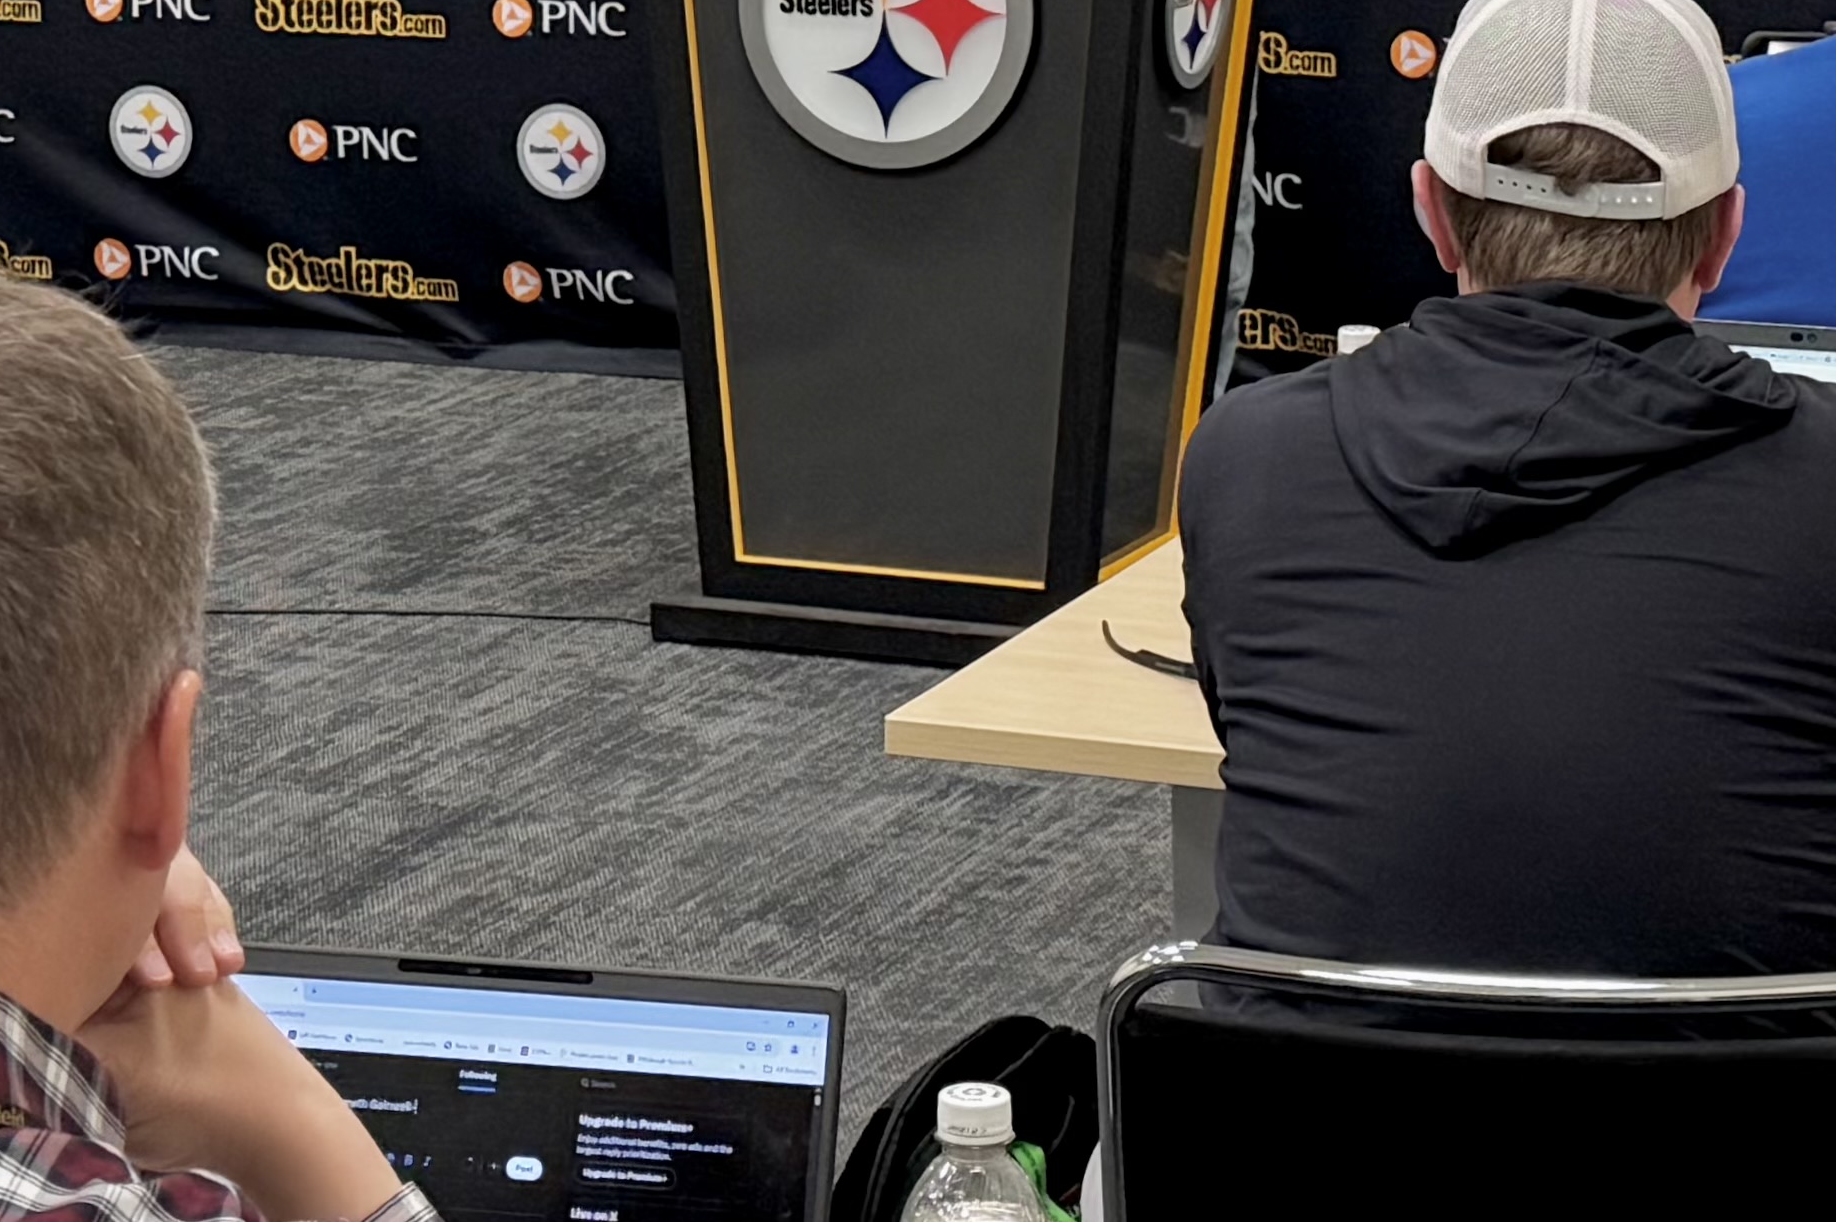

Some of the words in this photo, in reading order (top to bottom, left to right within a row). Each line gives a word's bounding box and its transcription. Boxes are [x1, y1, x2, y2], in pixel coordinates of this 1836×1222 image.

[539, 0, 625, 36] PNC
[335, 126, 416, 161] PNC
[529, 144, 559, 155] Steelers
[1251, 171, 1303, 210] NC
[137, 245, 219, 279] PNC
[268, 245, 458, 302] Steelers.com
[548, 269, 633, 303] PNC
[1237, 308, 1337, 357] ers.com
